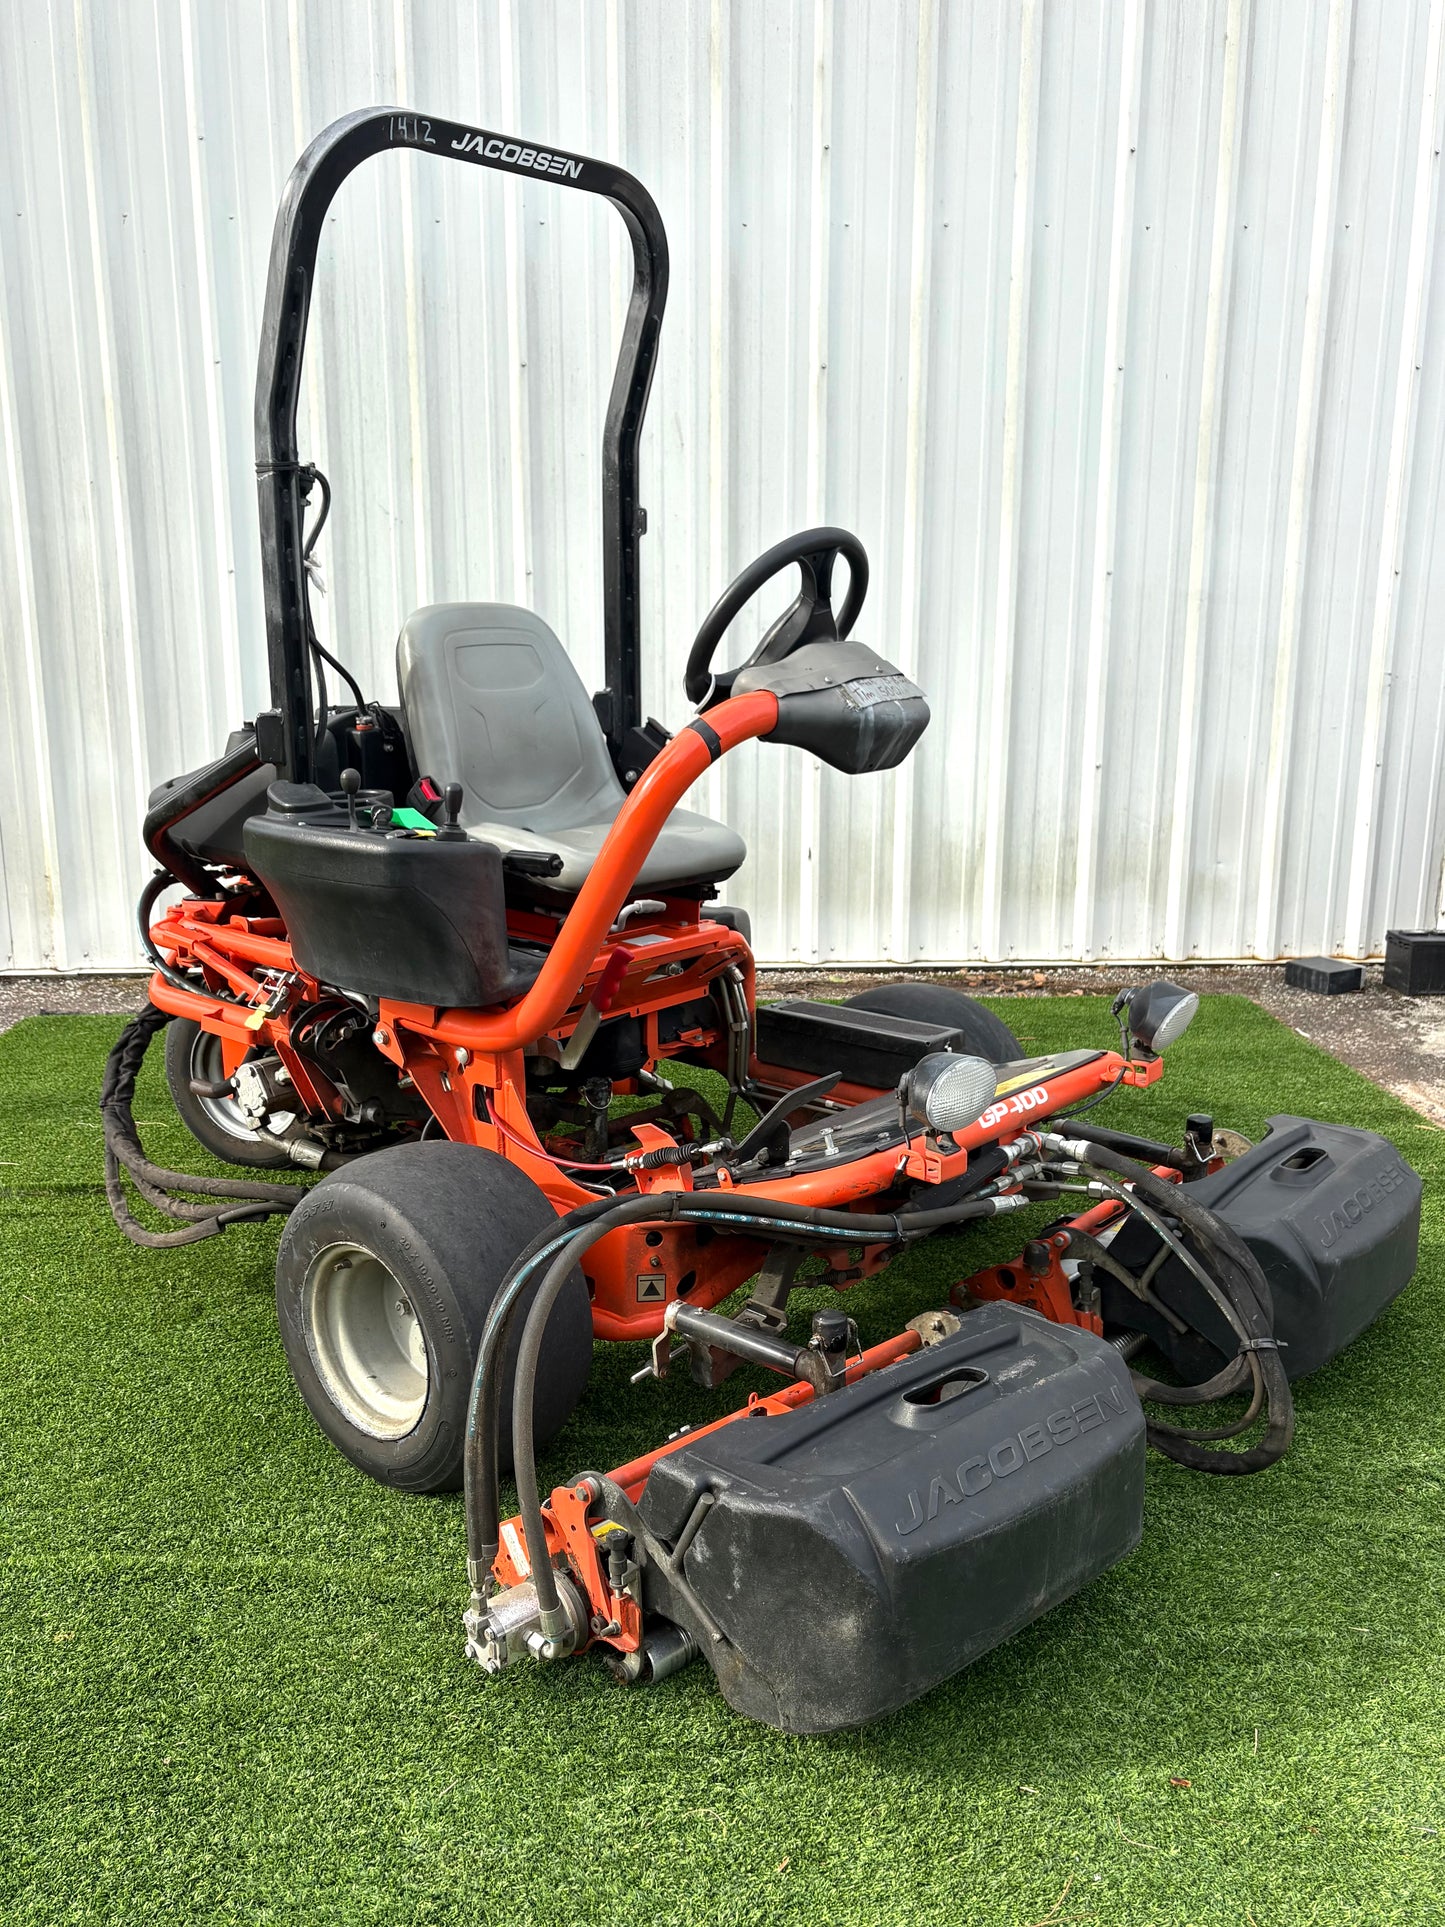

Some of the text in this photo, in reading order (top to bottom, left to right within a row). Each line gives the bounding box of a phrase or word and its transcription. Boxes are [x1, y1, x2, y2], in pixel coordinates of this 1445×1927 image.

[389, 116, 436, 145] 1412
[450, 132, 584, 179] JACOBSEN
[1313, 1158, 1411, 1249] JACOBSEN
[895, 1384, 1128, 1536] JACOBSEN
